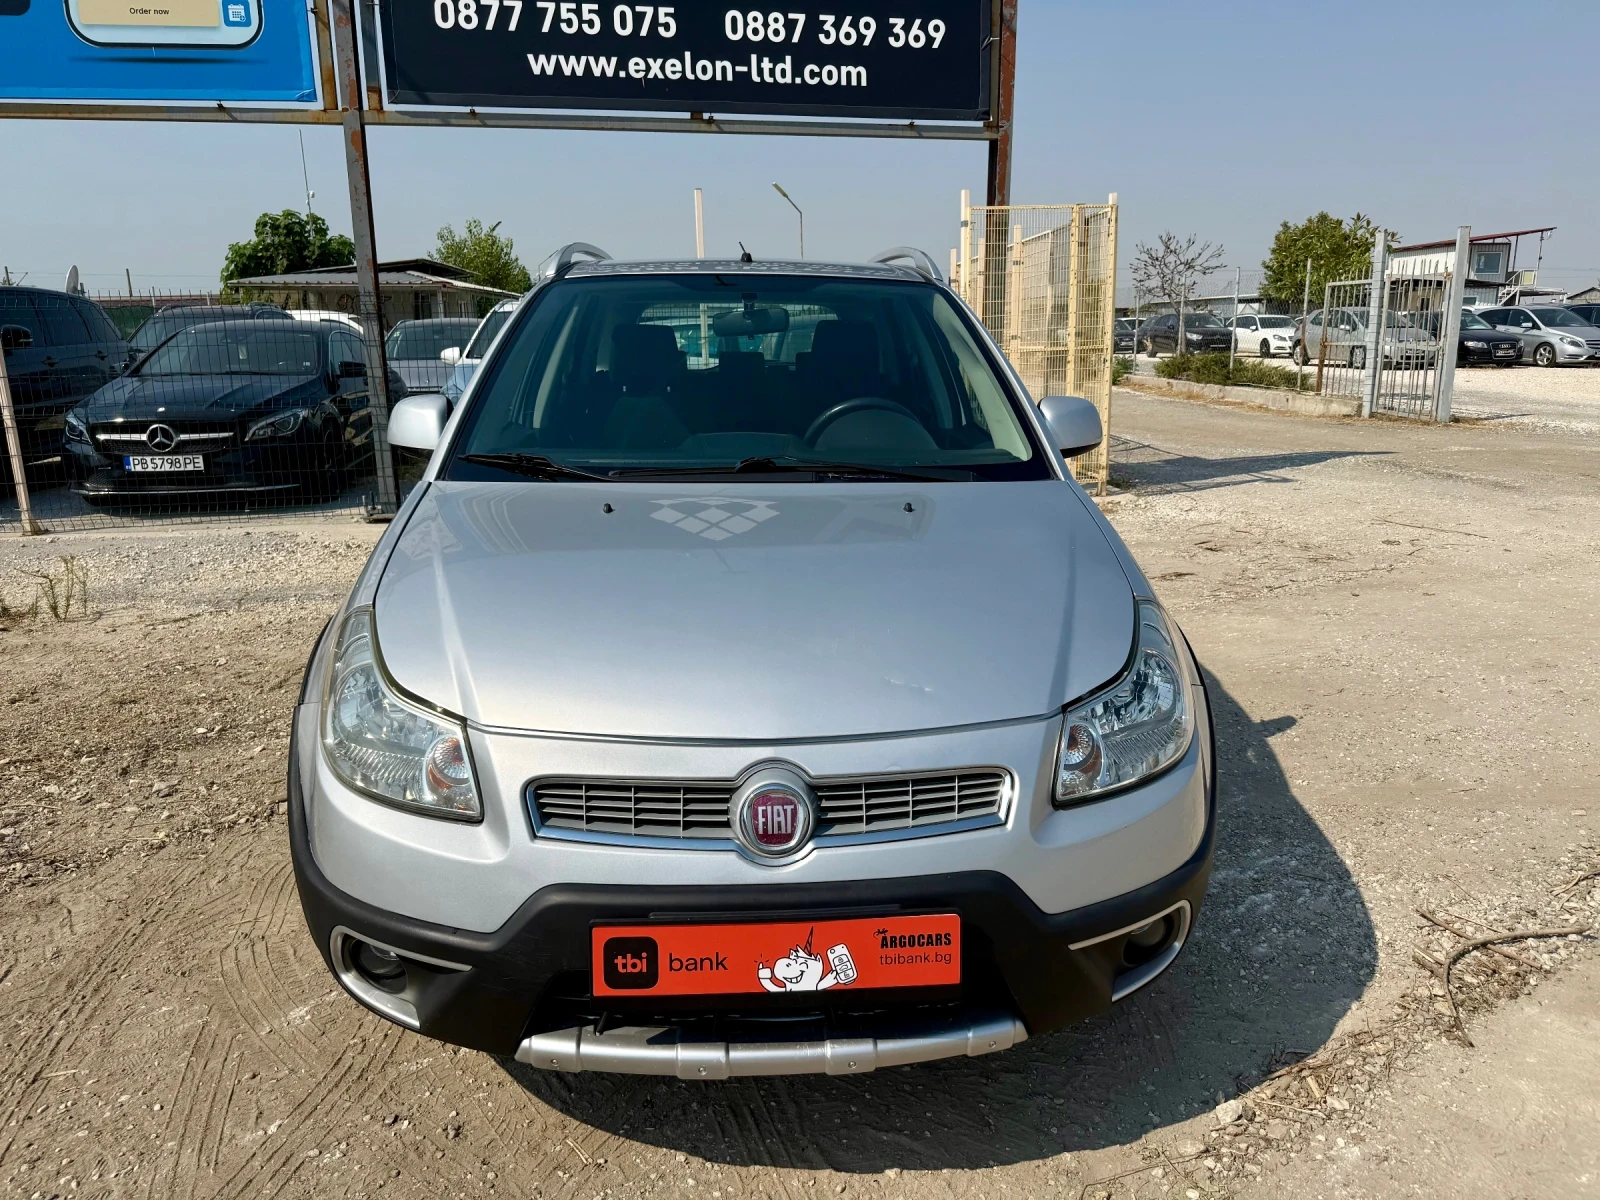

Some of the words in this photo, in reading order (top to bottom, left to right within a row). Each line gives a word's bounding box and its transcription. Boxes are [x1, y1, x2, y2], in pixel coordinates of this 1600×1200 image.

[129, 7, 151, 15] Order
[433, 0, 523, 31] 0877
[536, 1, 601, 35] 755
[613, 4, 677, 38] 075
[724, 9, 806, 43] 0887
[818, 14, 877, 46] 369
[888, 17, 946, 49] 369
[527, 50, 868, 87] www.exelon-ltd.com
[150, 457, 182, 470] 5798
[183, 456, 202, 469] PE
[757, 804, 794, 835] FIAT
[880, 932, 952, 949] ARGOCARS
[613, 951, 648, 973] tbi
[668, 951, 729, 972] bank
[879, 951, 952, 965] tbibank.bg
